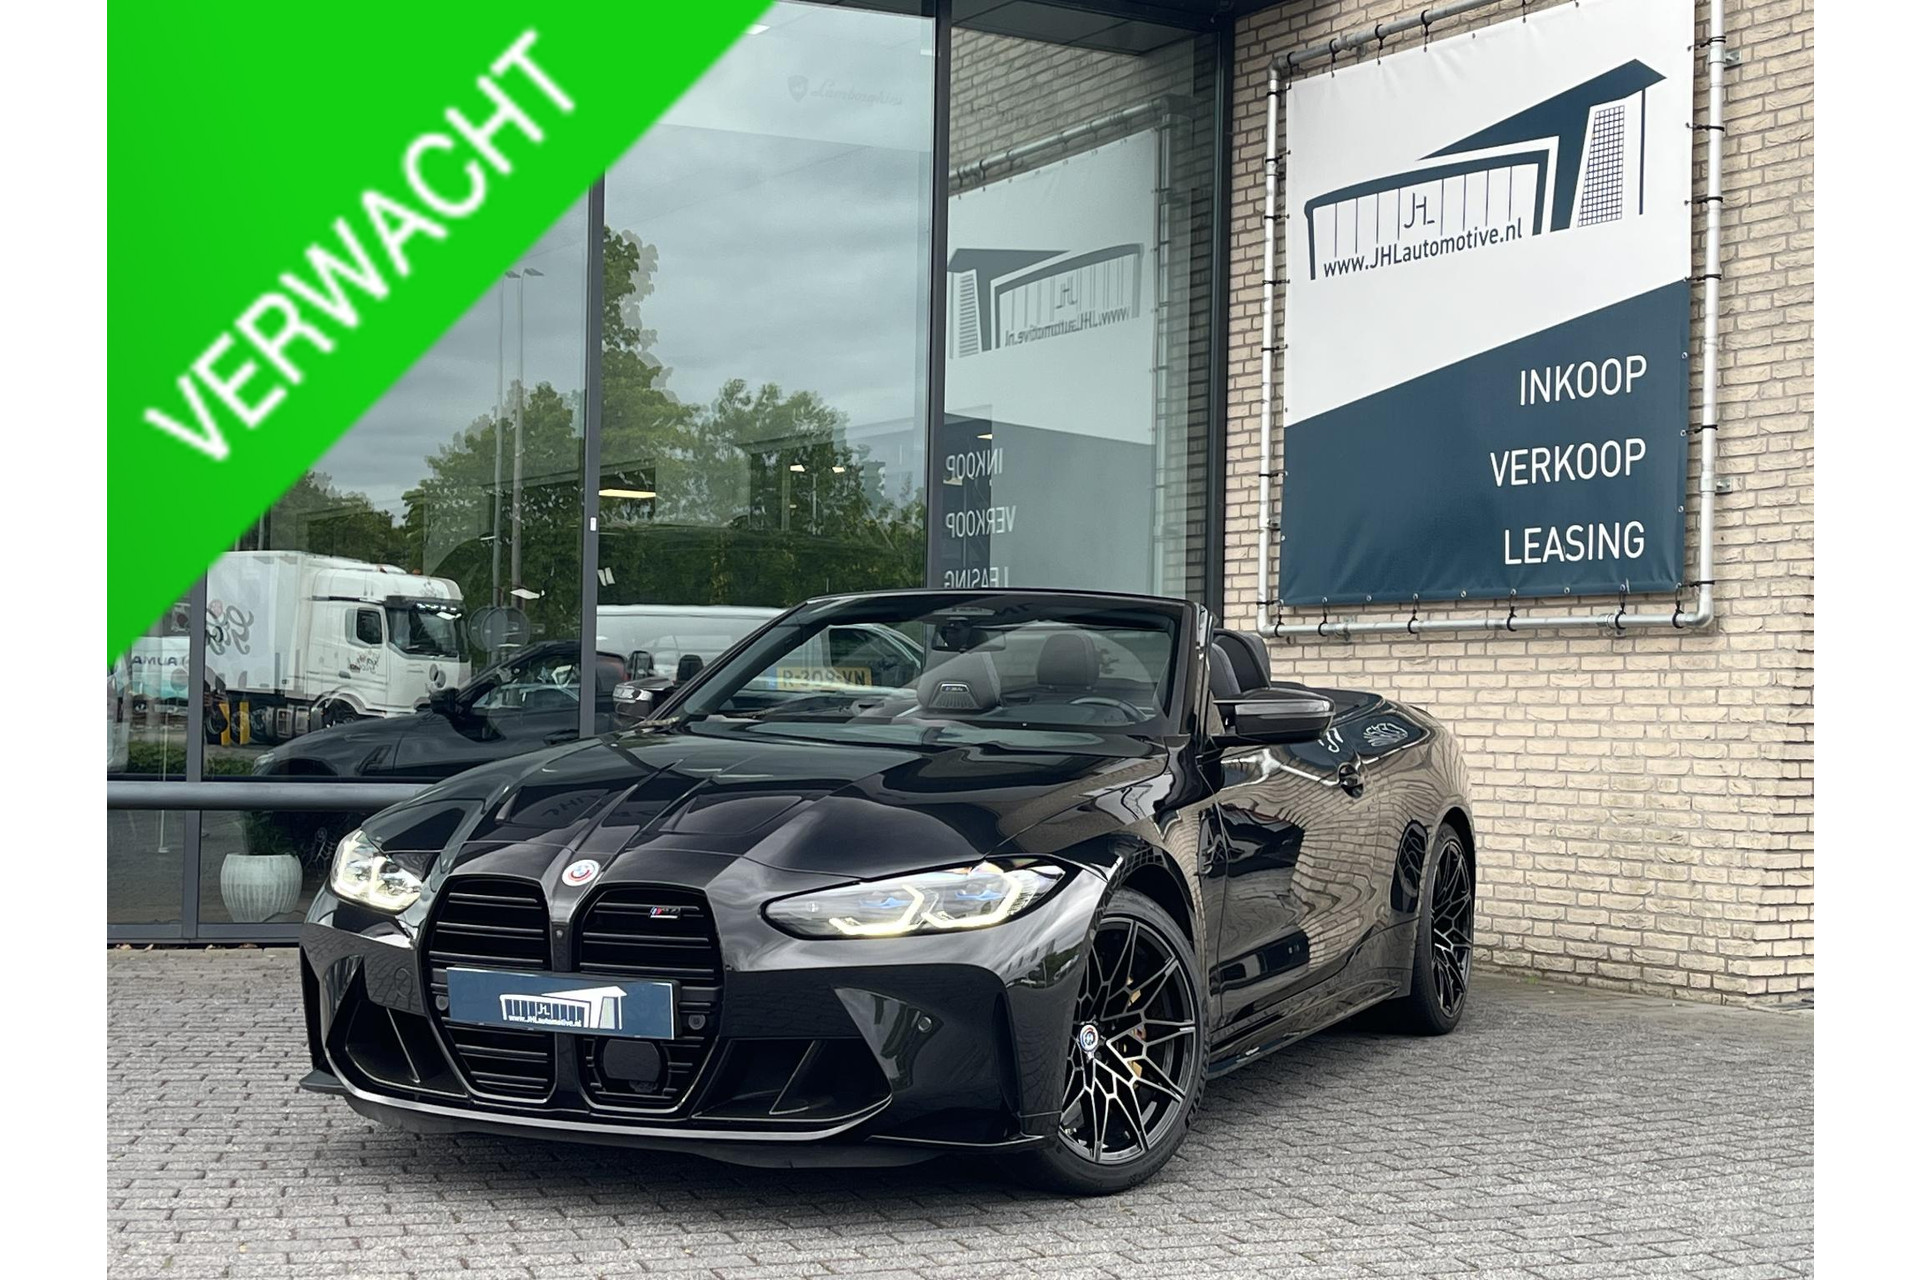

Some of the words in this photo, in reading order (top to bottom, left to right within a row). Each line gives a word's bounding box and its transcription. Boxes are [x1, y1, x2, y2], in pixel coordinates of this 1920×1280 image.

[1324, 217, 1522, 277] www.JHLautomotive.nl
[1520, 355, 1647, 406] INKOOP
[1490, 438, 1646, 487] VERKOOP
[1505, 521, 1645, 565] LEASING
